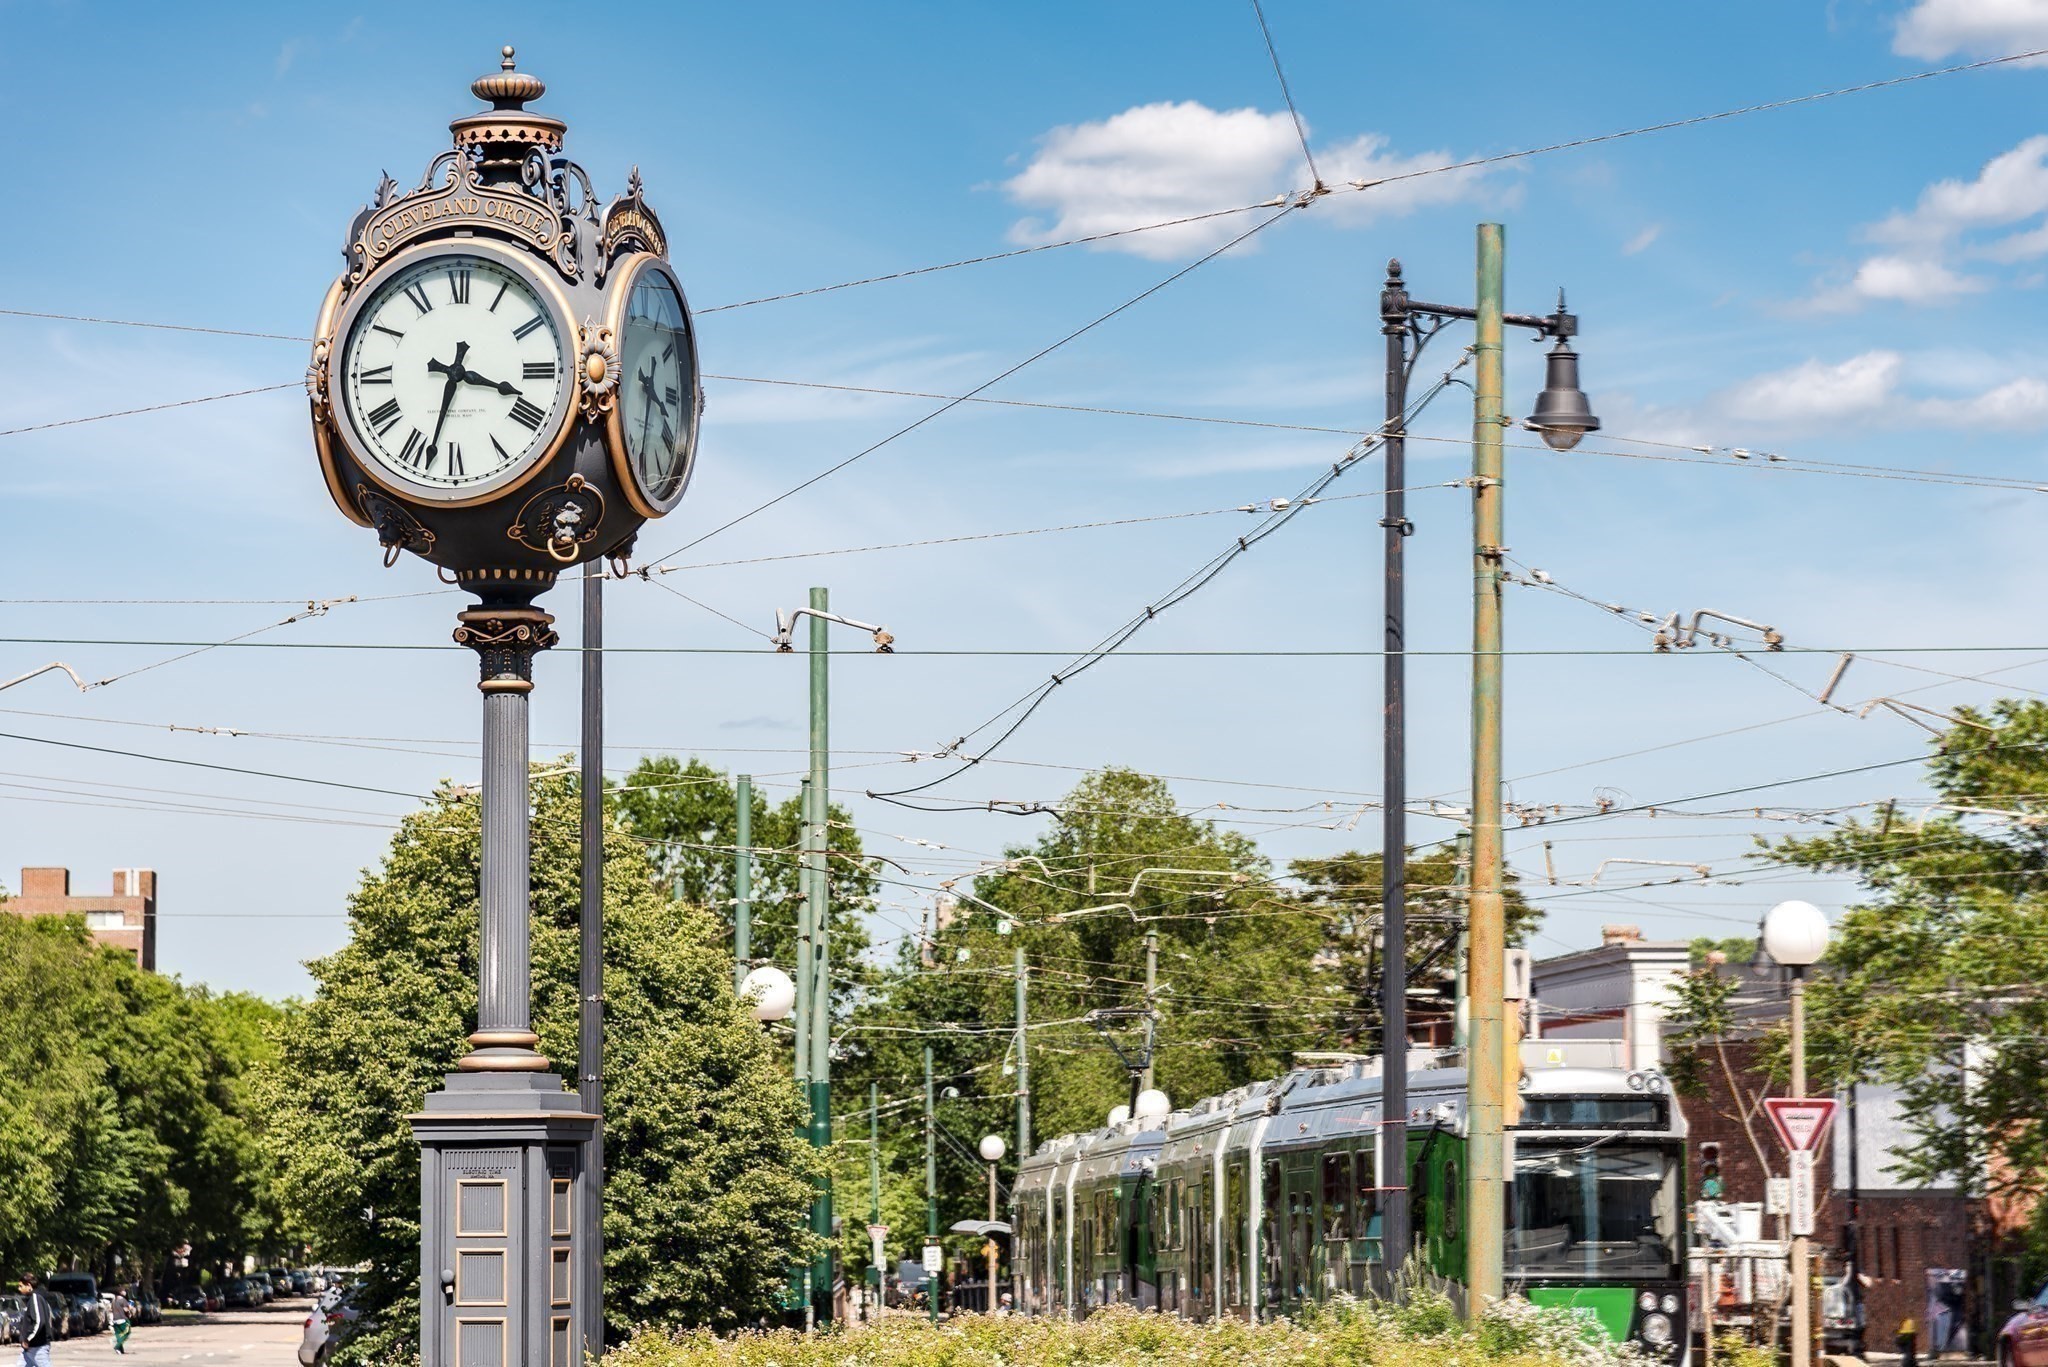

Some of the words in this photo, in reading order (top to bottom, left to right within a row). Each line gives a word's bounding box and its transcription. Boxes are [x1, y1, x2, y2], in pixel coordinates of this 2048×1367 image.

[381, 197, 480, 239] CLEVELAND
[484, 200, 545, 233] CIRCLE
[400, 279, 436, 321] XI
[446, 269, 474, 305] XII
[370, 314, 407, 349] X
[511, 311, 547, 344] II
[521, 357, 555, 383] III
[444, 441, 469, 476] VI
[489, 432, 513, 466] V
